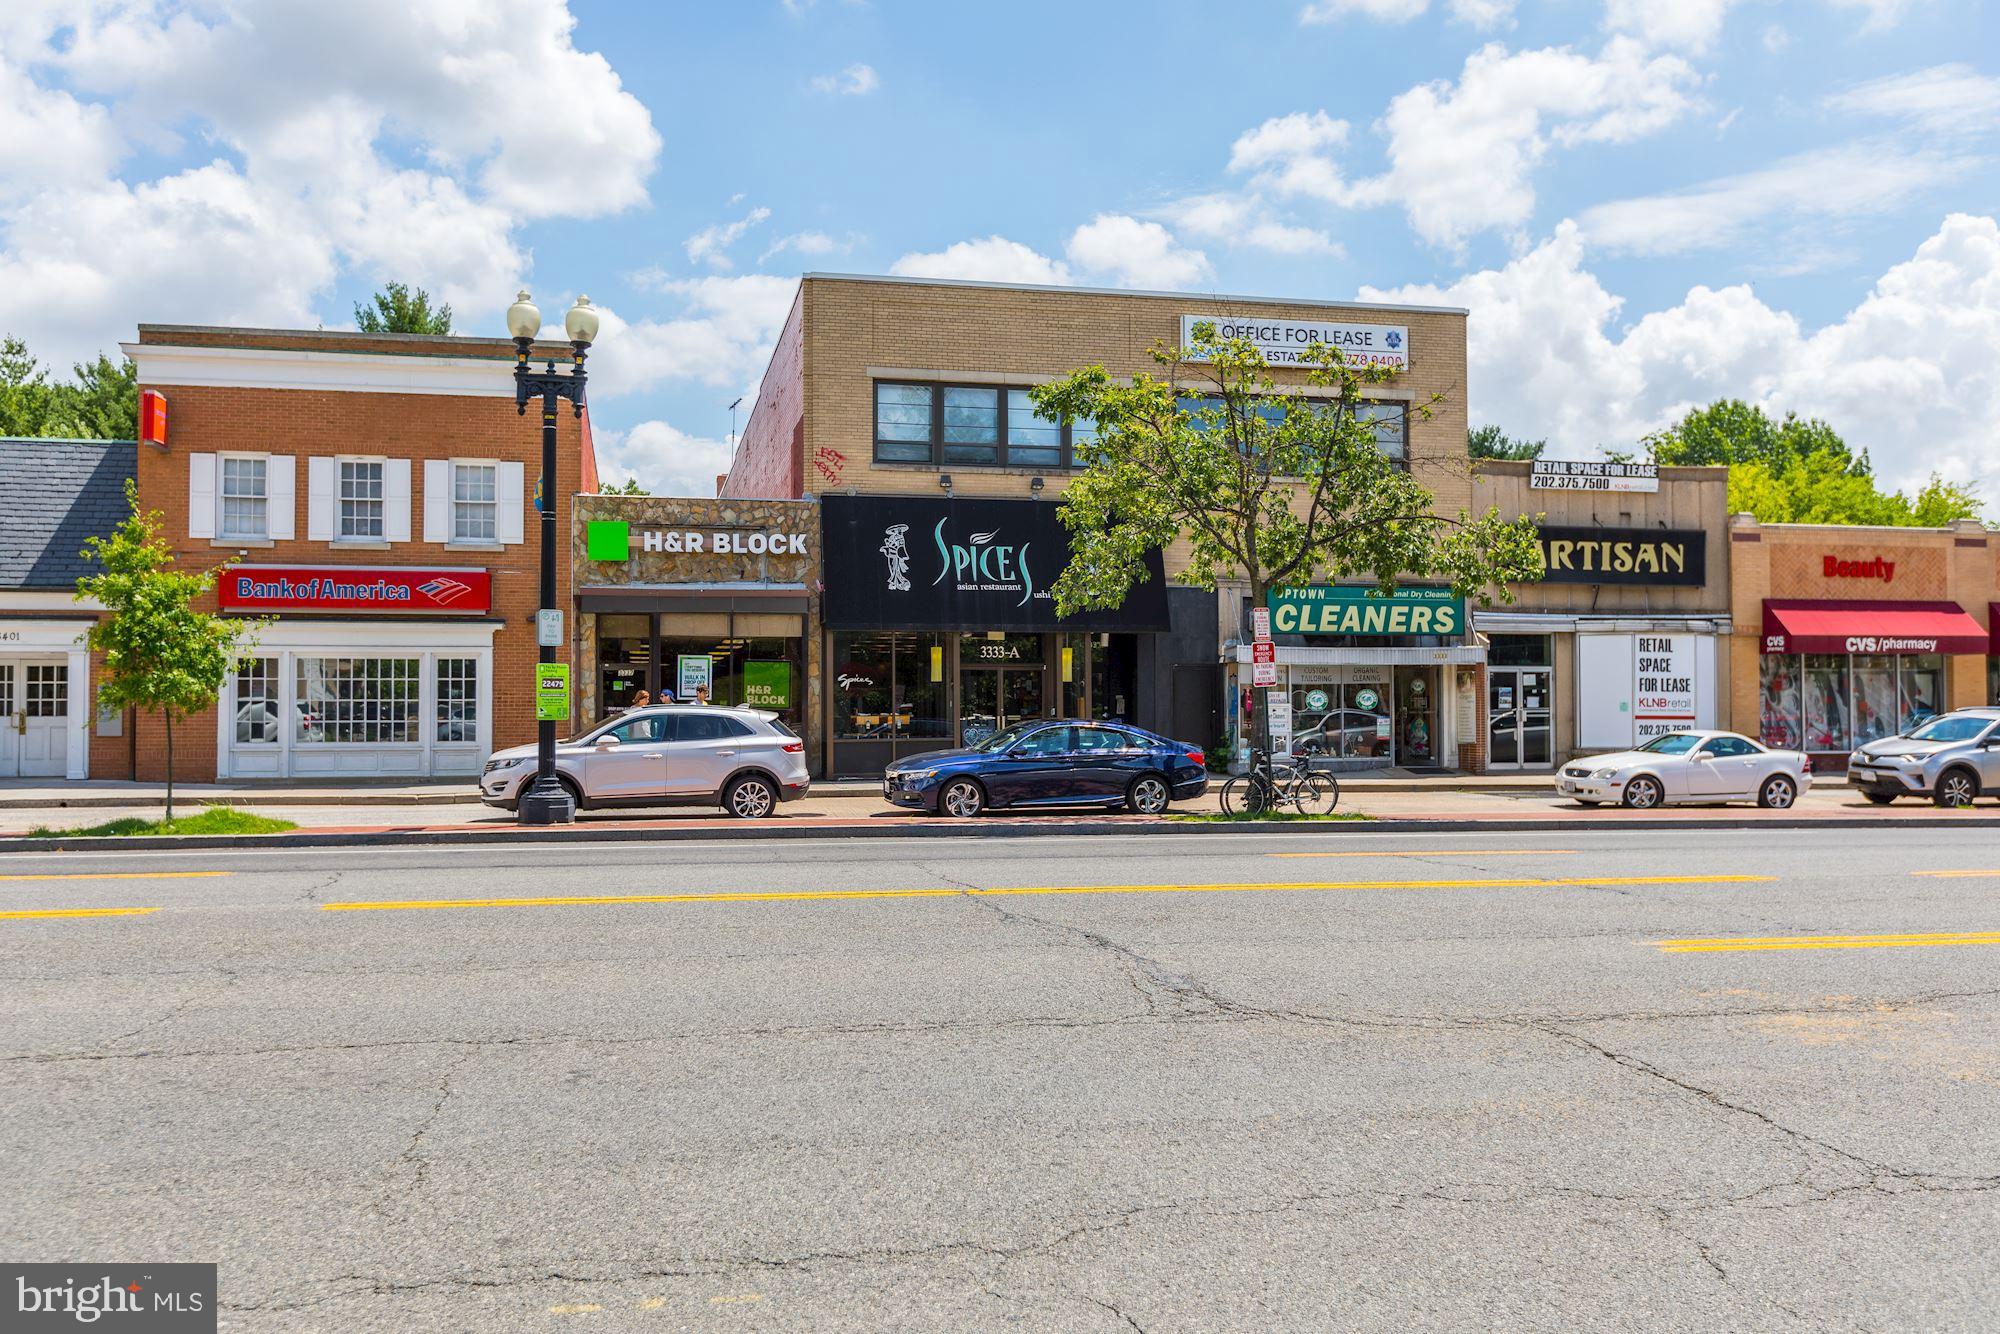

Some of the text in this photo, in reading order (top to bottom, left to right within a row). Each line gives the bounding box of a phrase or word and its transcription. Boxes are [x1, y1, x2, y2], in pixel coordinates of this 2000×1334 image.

[1222, 325, 1281, 342] OFFICE
[1285, 329, 1320, 343] FOR
[1324, 331, 1373, 346] LEASE
[1534, 461, 1657, 478] RETAIL SPACE FOR LEASE
[1534, 475, 1610, 489] 202.375.7500
[643, 531, 807, 554] H&R BLOCK
[1823, 555, 1896, 583] Beauty
[957, 582, 1022, 591] asian restaurant
[1410, 591, 1423, 599] Dry
[1275, 604, 1455, 634] CLEANERS
[1639, 638, 1673, 653] RETAIL
[1766, 636, 1785, 647] CVS
[1845, 637, 1937, 652] CVS/pharmacy
[980, 645, 1020, 659] 3333-A
[1303, 666, 1329, 674] CUSTOM
[1353, 666, 1380, 674] ORGANIC
[1639, 658, 1672, 673] SPACE
[542, 680, 564, 688] 22479
[837, 673, 874, 691] Spices
[1639, 678, 1691, 692] FOR LEASE
[746, 685, 772, 695] H&R
[746, 695, 786, 705] BLOCK
[1638, 724, 1692, 735] 202.3757500
